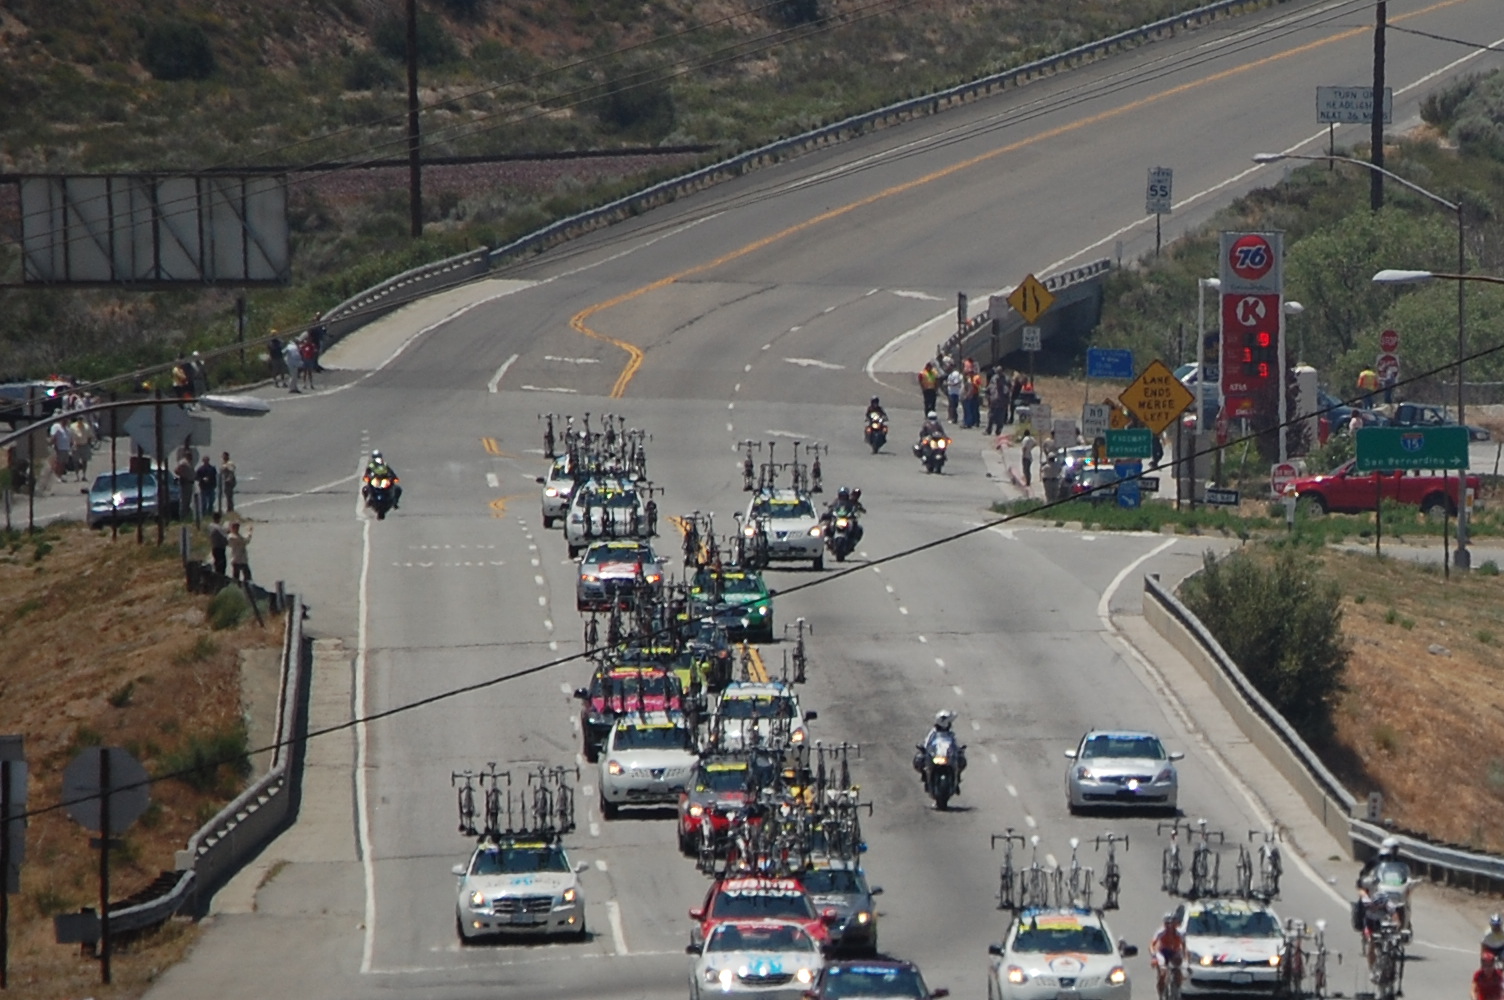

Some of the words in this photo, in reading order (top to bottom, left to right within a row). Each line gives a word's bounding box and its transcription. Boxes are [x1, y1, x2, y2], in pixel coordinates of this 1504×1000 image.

[1150, 184, 1168, 197] 55
[1236, 244, 1267, 269] 76
[1142, 376, 1171, 384] LANE
[1143, 387, 1171, 398] ENDS
[1138, 400, 1175, 409] MERGE
[1143, 412, 1169, 421] LEFT
[1407, 440, 1419, 449] 15
[1365, 458, 1384, 466] San
[1388, 457, 1445, 465] Bernardino
[724, 889, 801, 897] VOLVO
